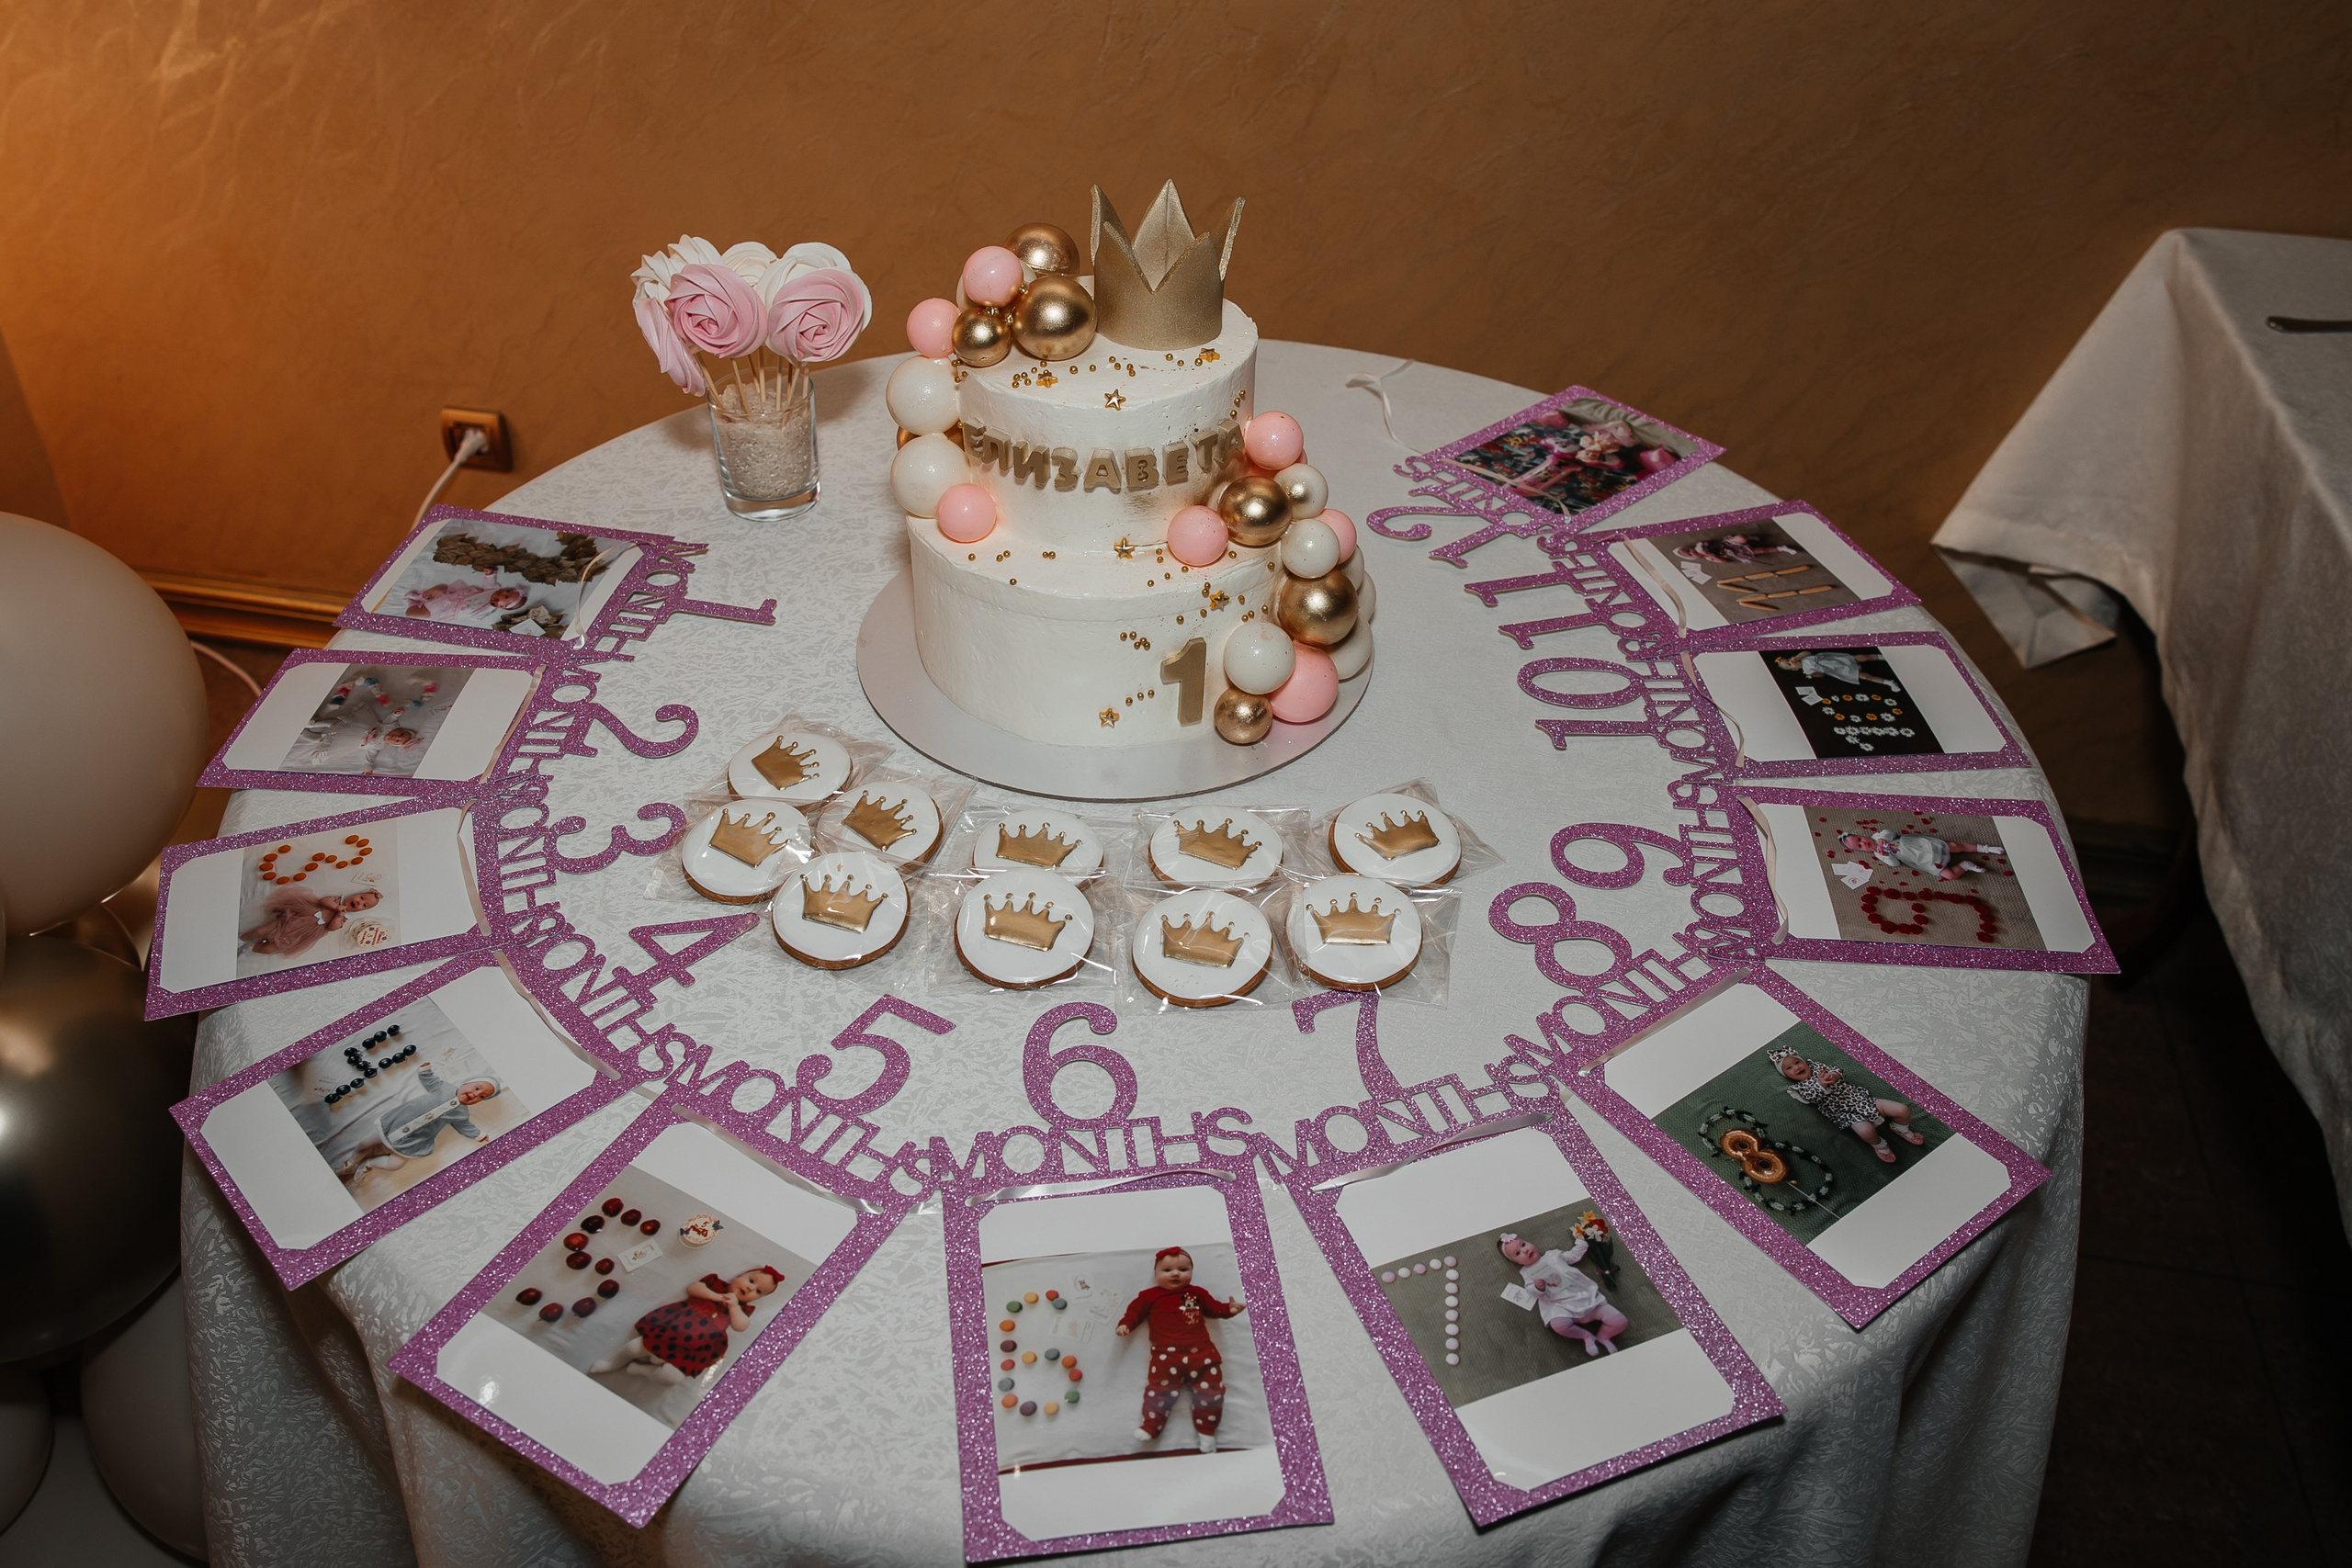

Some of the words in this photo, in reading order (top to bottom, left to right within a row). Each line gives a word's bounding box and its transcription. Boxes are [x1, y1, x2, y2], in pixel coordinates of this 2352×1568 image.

[963, 418, 1245, 493] ЕЛИЗАВЕТА
[1366, 487, 1507, 570] 12
[586, 538, 708, 663] MONTH
[660, 588, 777, 626] 1
[1464, 562, 1599, 649] 11
[1159, 637, 1208, 726] 1
[1517, 656, 1654, 750] 10
[559, 704, 700, 760] 2
[549, 802, 687, 874] 3
[1550, 822, 1698, 890] 9
[612, 912, 760, 987] 4
[1488, 882, 1632, 992] 8
[796, 994, 956, 1118] 5
[1023, 1001, 1137, 1128] 6
[1292, 990, 1404, 1100] 7
[663, 1044, 948, 1201] MONTHS
[929, 1107, 1253, 1181] MONTHS
[1254, 1055, 1560, 1184] MONTHS
